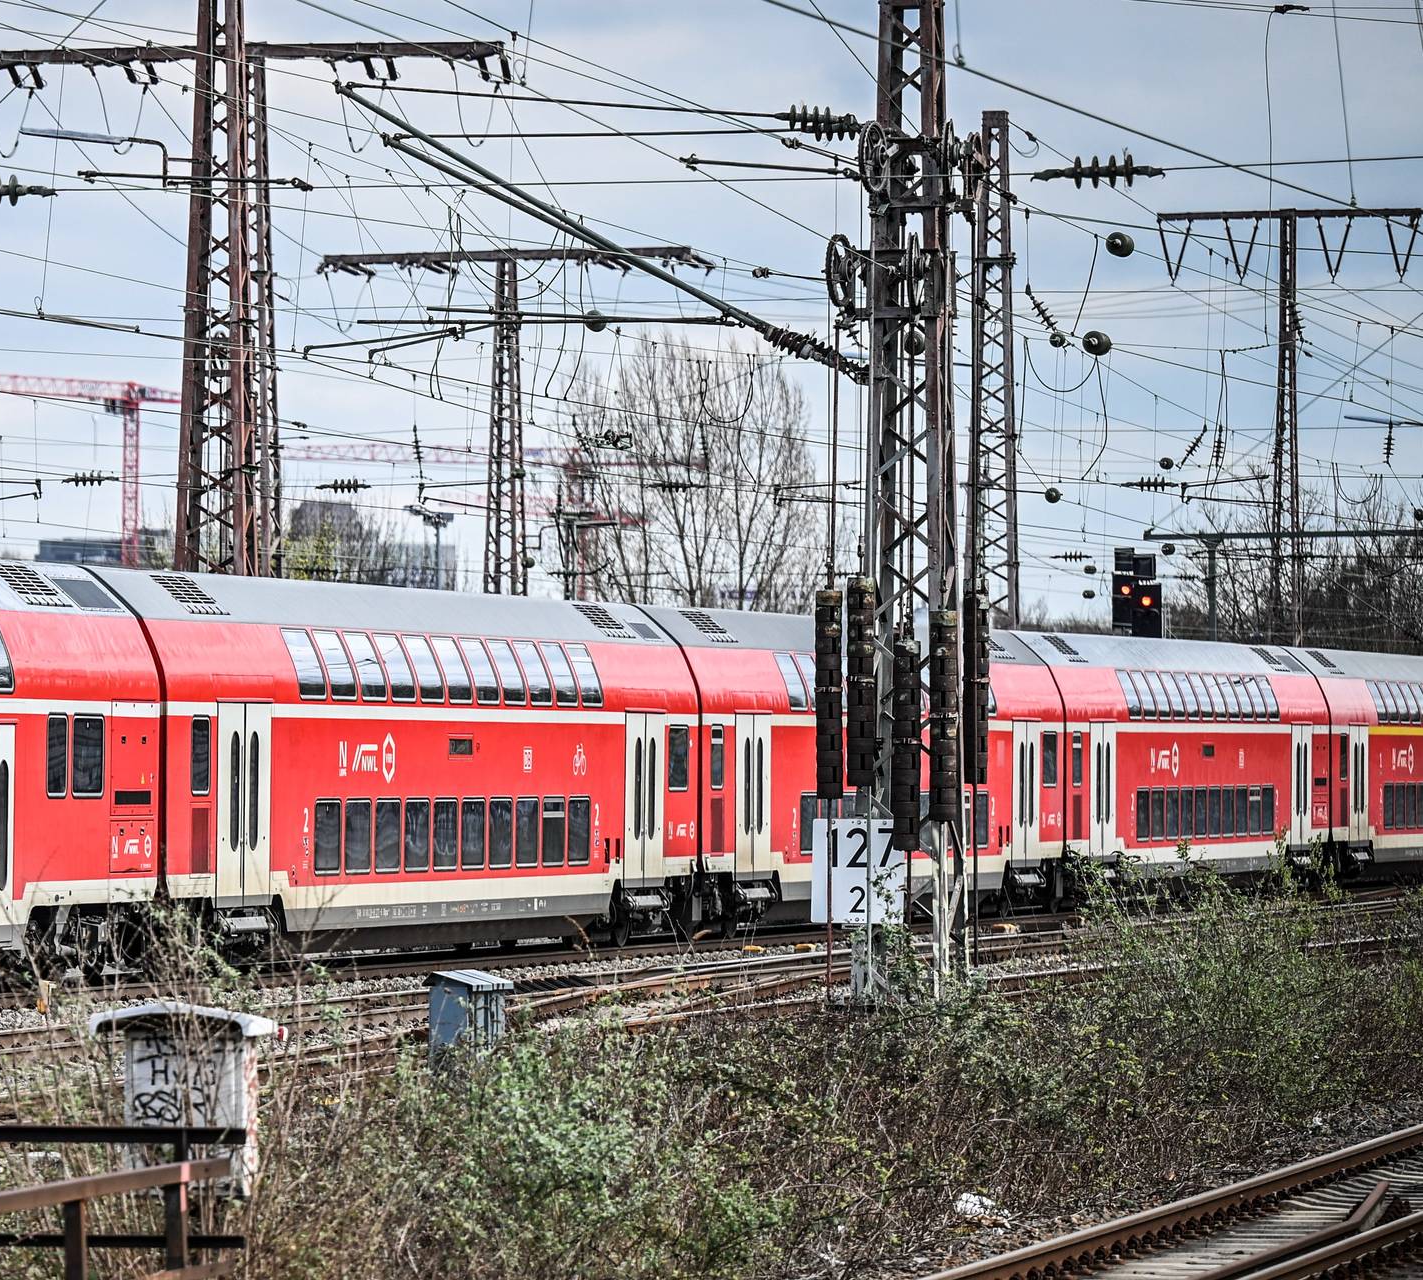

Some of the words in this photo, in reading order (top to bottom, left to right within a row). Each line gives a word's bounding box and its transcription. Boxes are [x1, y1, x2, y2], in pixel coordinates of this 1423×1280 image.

[361, 755, 378, 772] NWL
[303, 807, 309, 833] 2
[594, 803, 600, 826] 2
[830, 827, 894, 868] 127
[848, 886, 866, 914] 2
